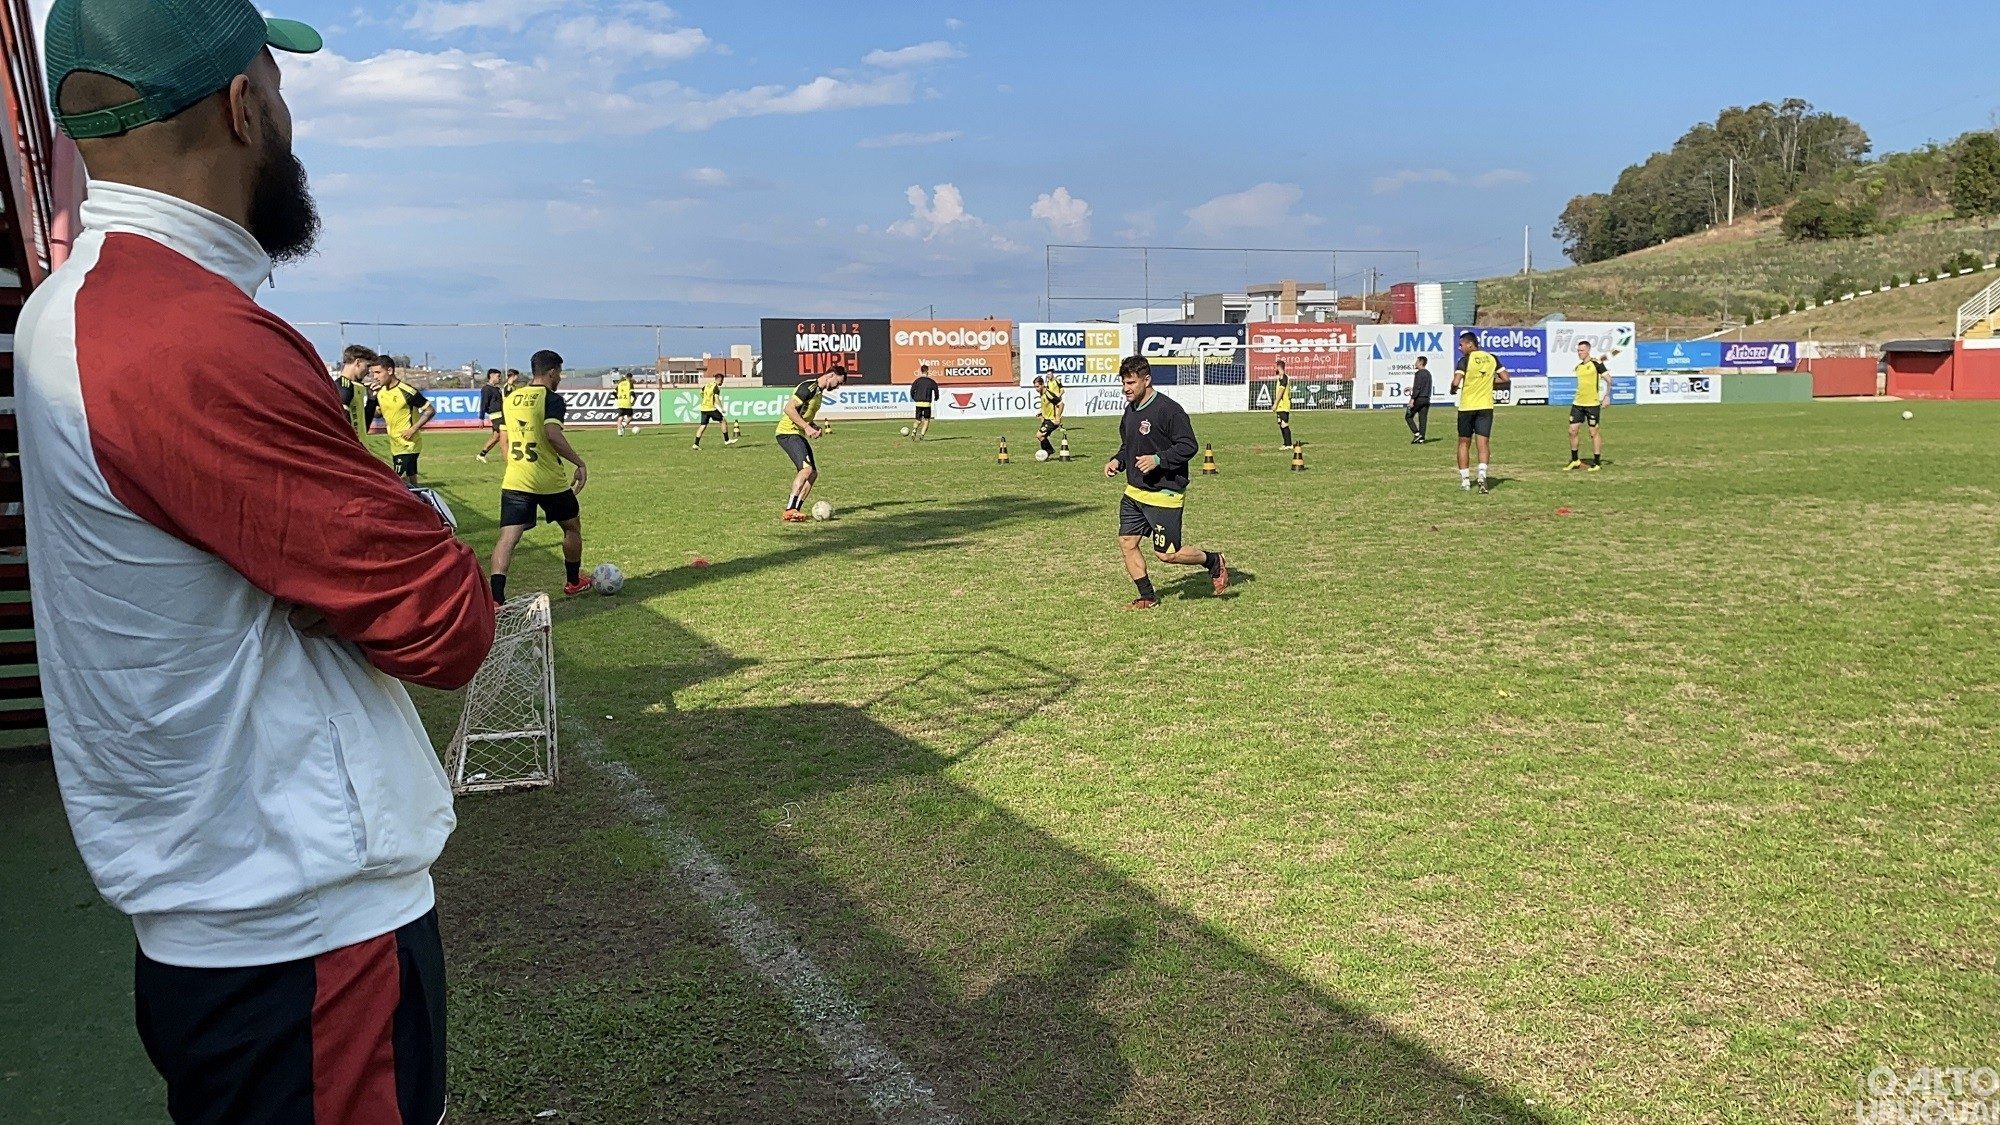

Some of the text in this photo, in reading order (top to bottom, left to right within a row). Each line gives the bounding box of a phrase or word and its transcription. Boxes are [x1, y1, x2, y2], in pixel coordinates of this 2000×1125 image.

[797, 323, 860, 334] CRELUZ
[795, 334, 861, 352] MERCADO
[894, 327, 1009, 351] embalagio
[1039, 332, 1113, 347] BAKOF TEC
[1262, 333, 1349, 353] Barril
[1393, 331, 1444, 353] JMX
[918, 358, 987, 367] Vem ser DONO
[1275, 354, 1301, 363] Ferro
[1313, 354, 1331, 364] Aço
[1731, 343, 1790, 364] Arbaza 40
[800, 352, 858, 375] LIVRE
[945, 367, 992, 377] NEGÓCIO!
[1039, 357, 1113, 372] BAKOF TEC
[979, 391, 1042, 411] vitrola
[1098, 387, 1121, 398] Posto
[426, 395, 481, 414] REV
[720, 394, 790, 417] icredi
[1085, 395, 1126, 415] Aveni
[584, 410, 652, 421] Servos
[510, 441, 539, 463] 55
[1154, 533, 1166, 548] 39
